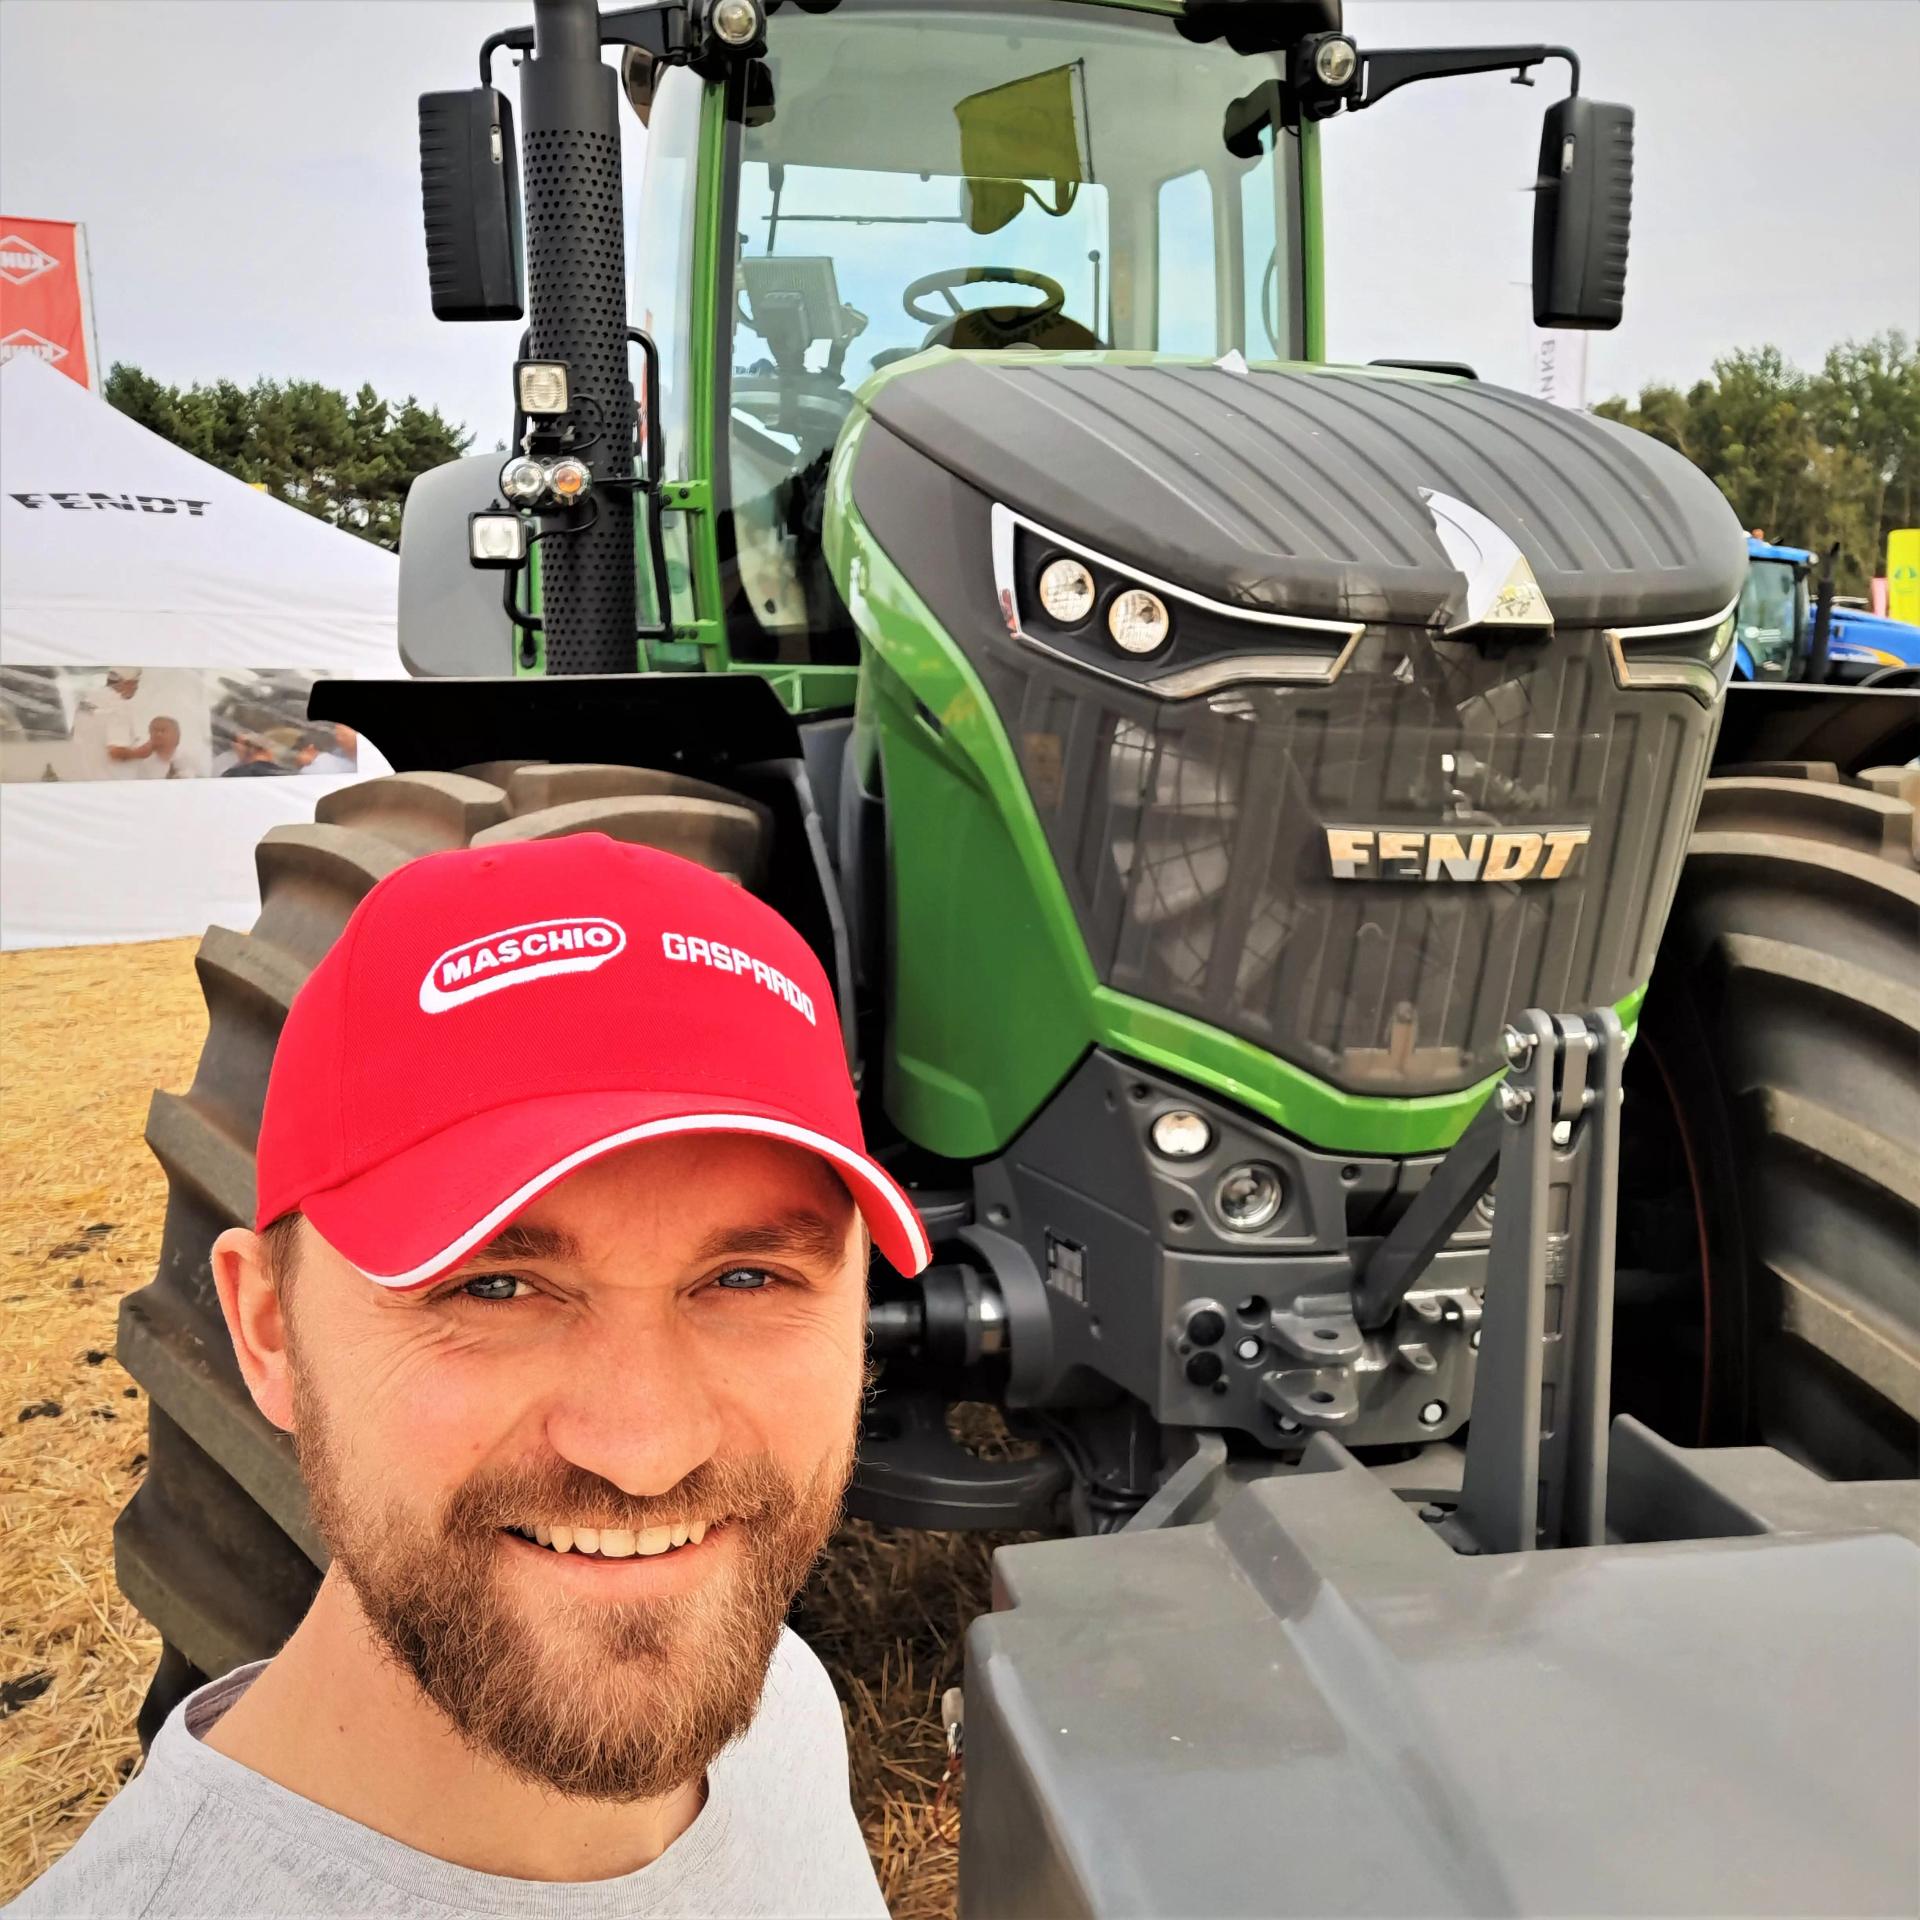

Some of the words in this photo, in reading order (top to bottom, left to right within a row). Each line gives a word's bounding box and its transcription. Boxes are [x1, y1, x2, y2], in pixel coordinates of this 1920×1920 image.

[8, 492, 213, 516] FENDT
[1326, 829, 1591, 882] FENDT
[442, 927, 613, 986] MASCHIO
[661, 931, 816, 1026] GASPARDO
